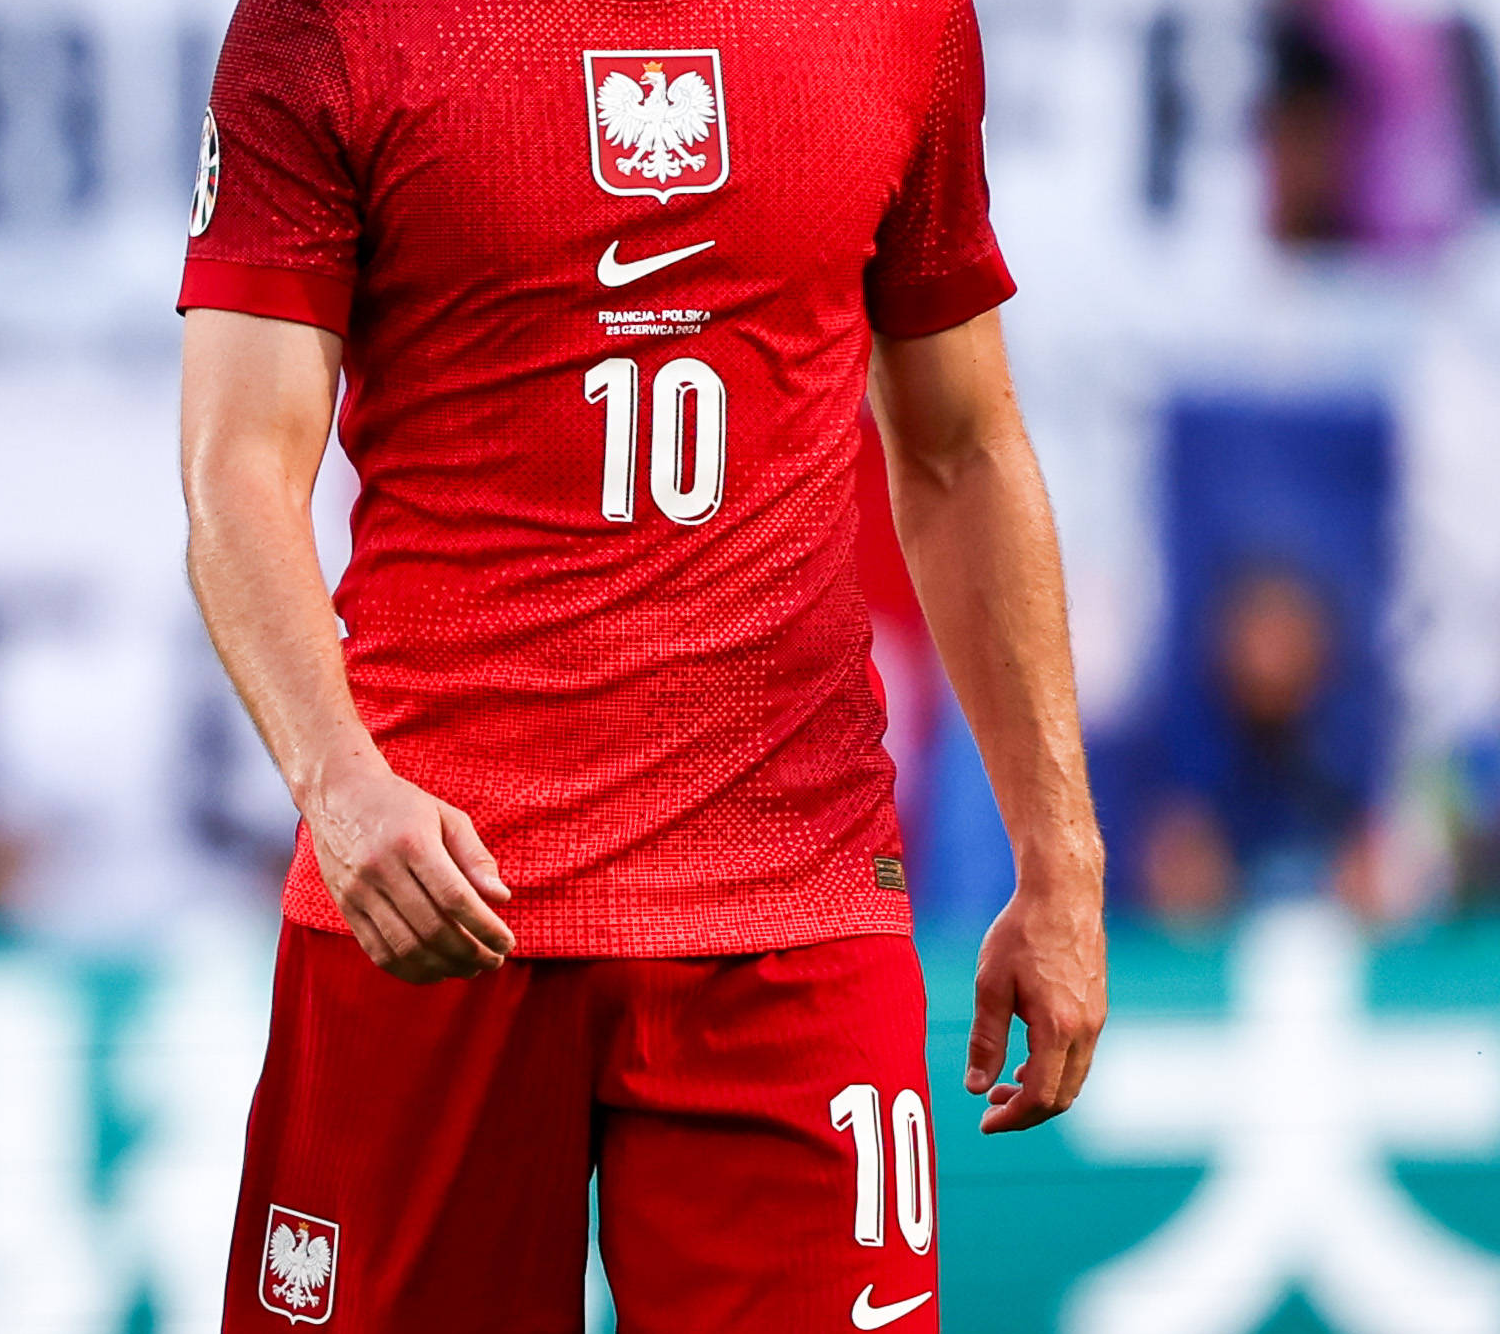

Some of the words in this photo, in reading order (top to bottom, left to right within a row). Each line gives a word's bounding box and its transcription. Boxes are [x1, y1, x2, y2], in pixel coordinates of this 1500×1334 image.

[606, 325, 620, 335] 25
[621, 324, 674, 335] CZERWCA
[675, 324, 701, 335] 2024
[584, 357, 727, 526] 10
[829, 1084, 933, 1255] 10
